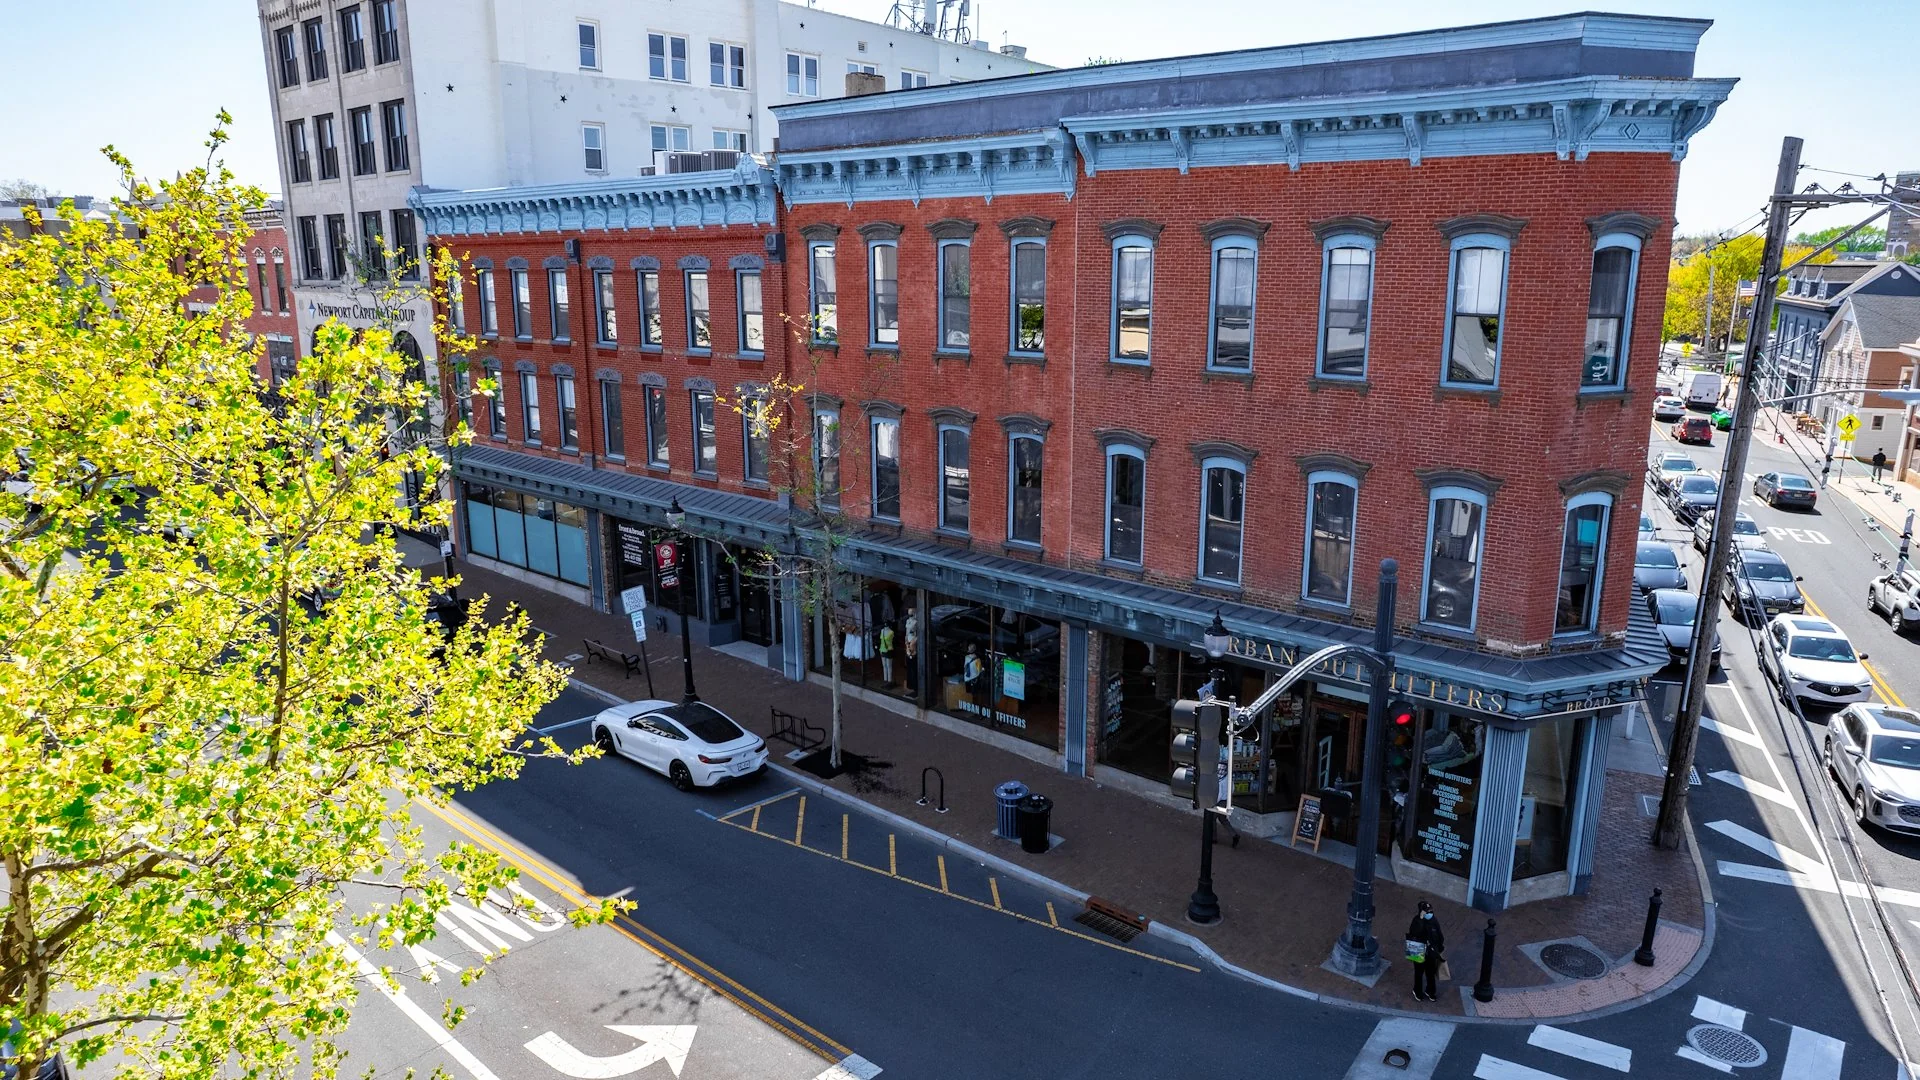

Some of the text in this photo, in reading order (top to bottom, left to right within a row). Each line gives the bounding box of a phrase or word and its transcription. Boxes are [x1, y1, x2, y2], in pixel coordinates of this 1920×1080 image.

[1766, 526, 1832, 545] PED
[1227, 635, 1294, 666] RBAN
[958, 700, 980, 715] URBAN
[1566, 696, 1611, 713] BROAD
[1432, 789, 1463, 802] ACCESSORIES
[1437, 836, 1470, 850] PHOTOGRAPHY
[1448, 832, 1460, 841] TECH
[1435, 853, 1447, 862] SALE
